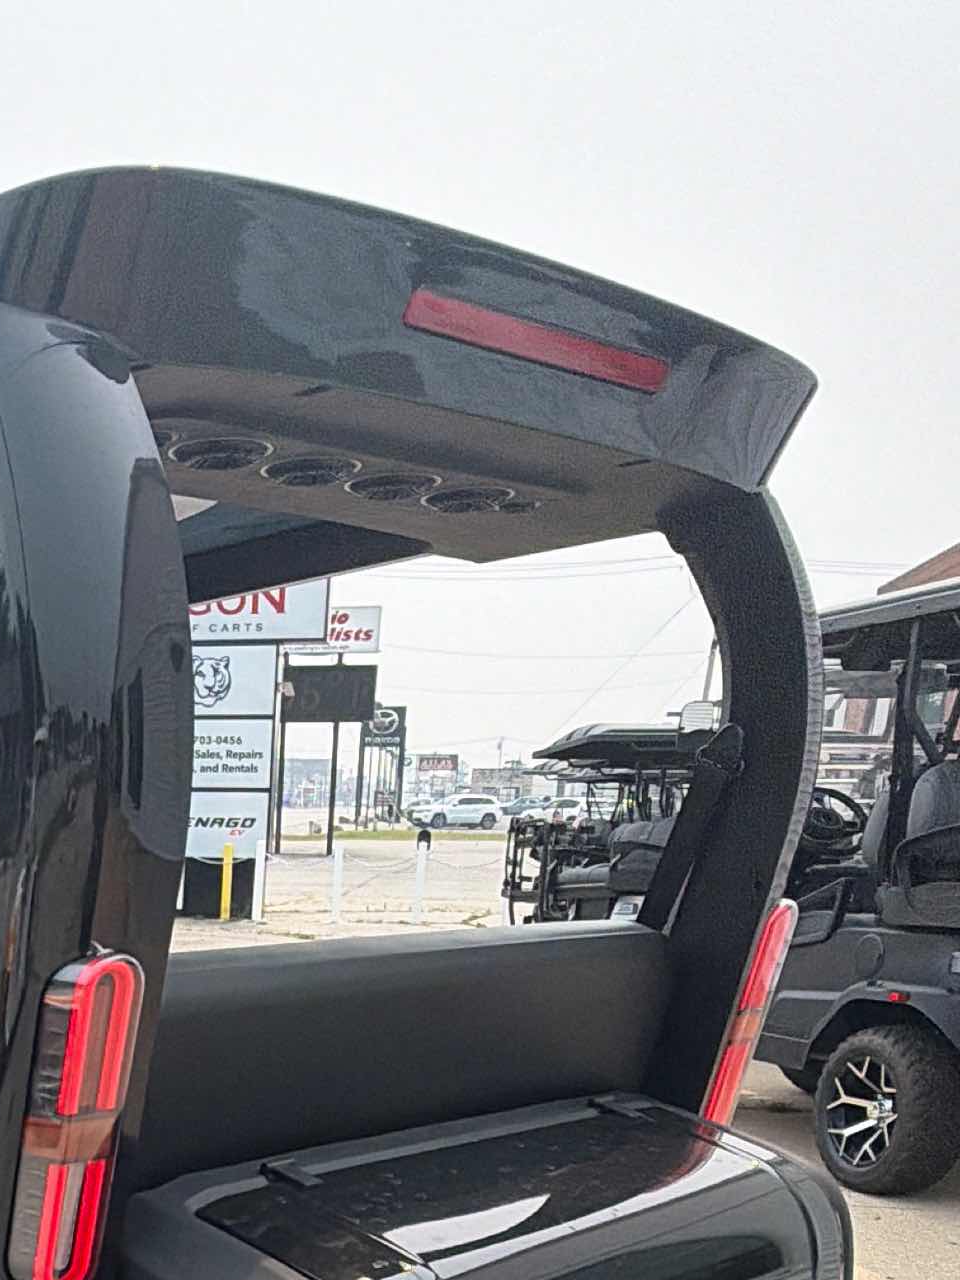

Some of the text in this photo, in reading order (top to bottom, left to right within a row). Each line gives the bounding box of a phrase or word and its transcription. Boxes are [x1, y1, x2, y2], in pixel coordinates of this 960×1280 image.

[209, 623, 264, 633] CARTS
[225, 749, 264, 761] Repairs
[199, 763, 259, 773] and Rentals
